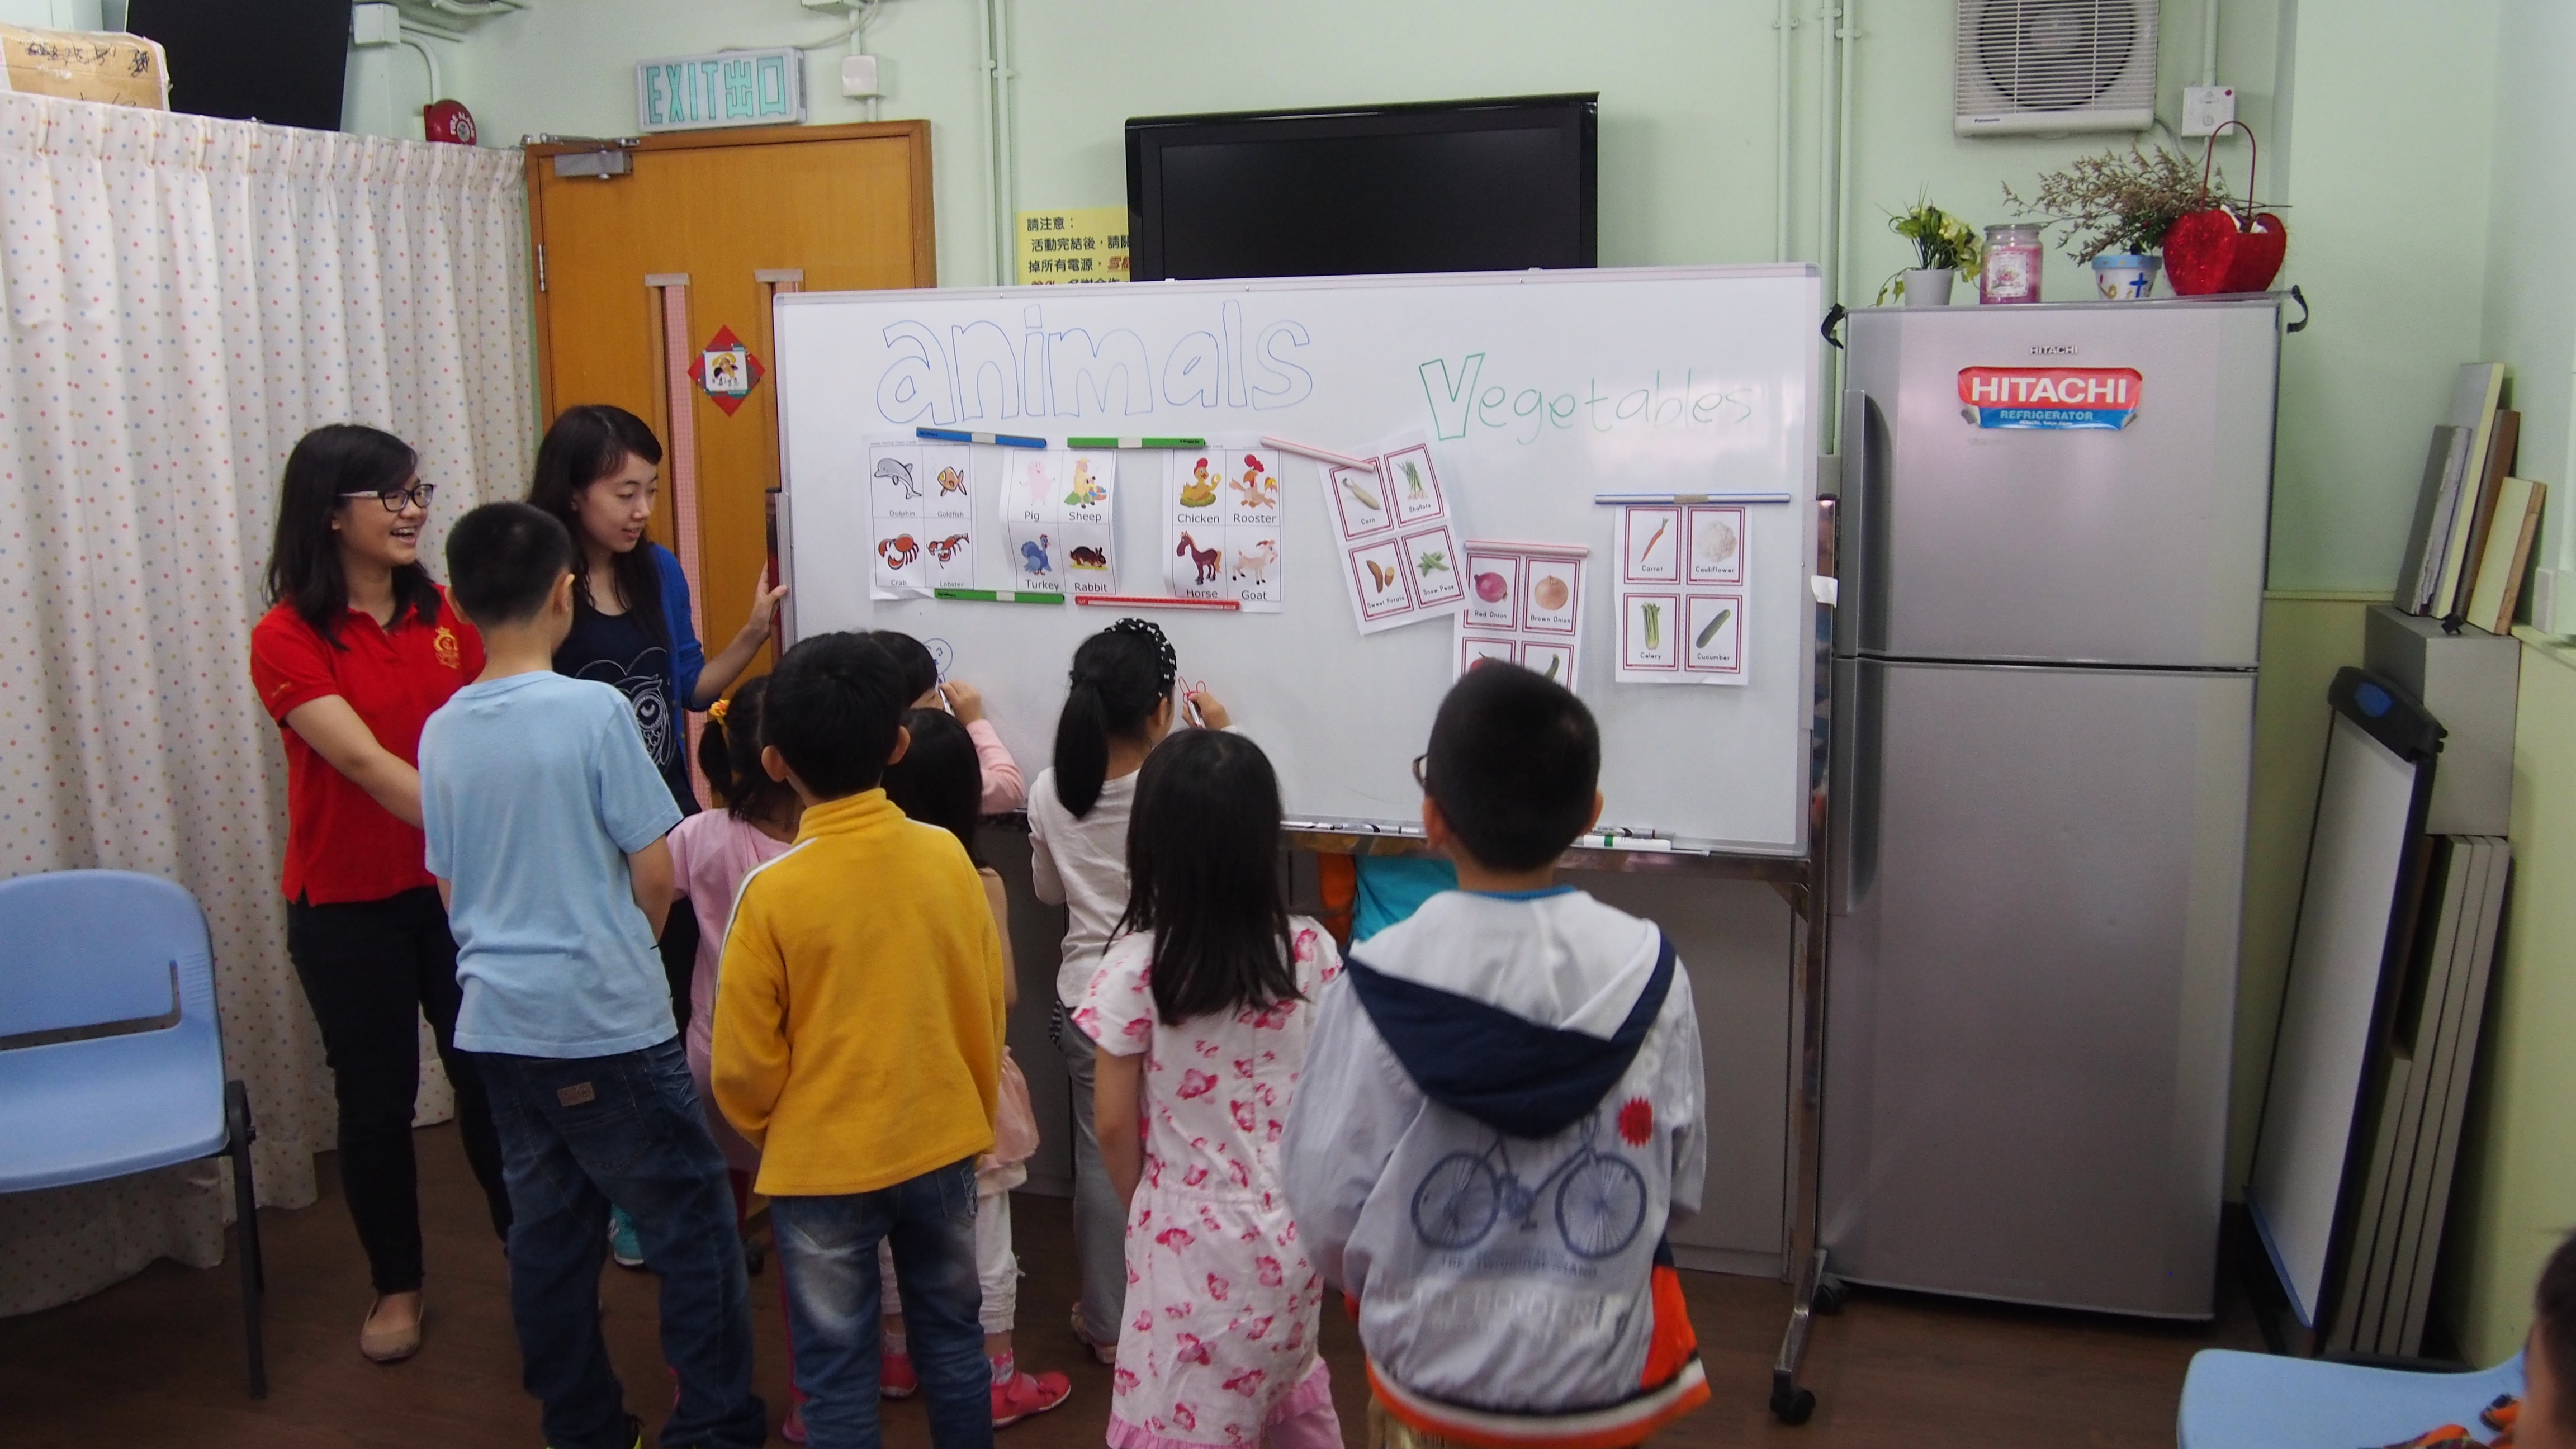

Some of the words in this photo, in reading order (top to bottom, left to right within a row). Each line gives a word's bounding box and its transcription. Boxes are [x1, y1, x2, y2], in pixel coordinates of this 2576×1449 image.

[646, 60, 717, 123] EXIT
[724, 56, 786, 118] 出口
[1027, 216, 1073, 231] 請注意：
[2029, 345, 2078, 354] HITACHI
[877, 300, 1313, 425] animals
[1972, 377, 2127, 404] HITACHI
[1419, 353, 1753, 445] Vegetables
[2000, 410, 2094, 420] REFRIGERATOR
[1409, 504, 1431, 513] Shallots
[1025, 511, 1040, 521] Pig
[1068, 511, 1102, 522] Sheep
[1177, 513, 1220, 523] Chicken
[1233, 513, 1276, 523] Rooster
[1025, 579, 1060, 591] Turkey
[1074, 583, 1108, 593] Rabbit
[1186, 589, 1218, 598] Horse
[1241, 590, 1267, 600] Goat
